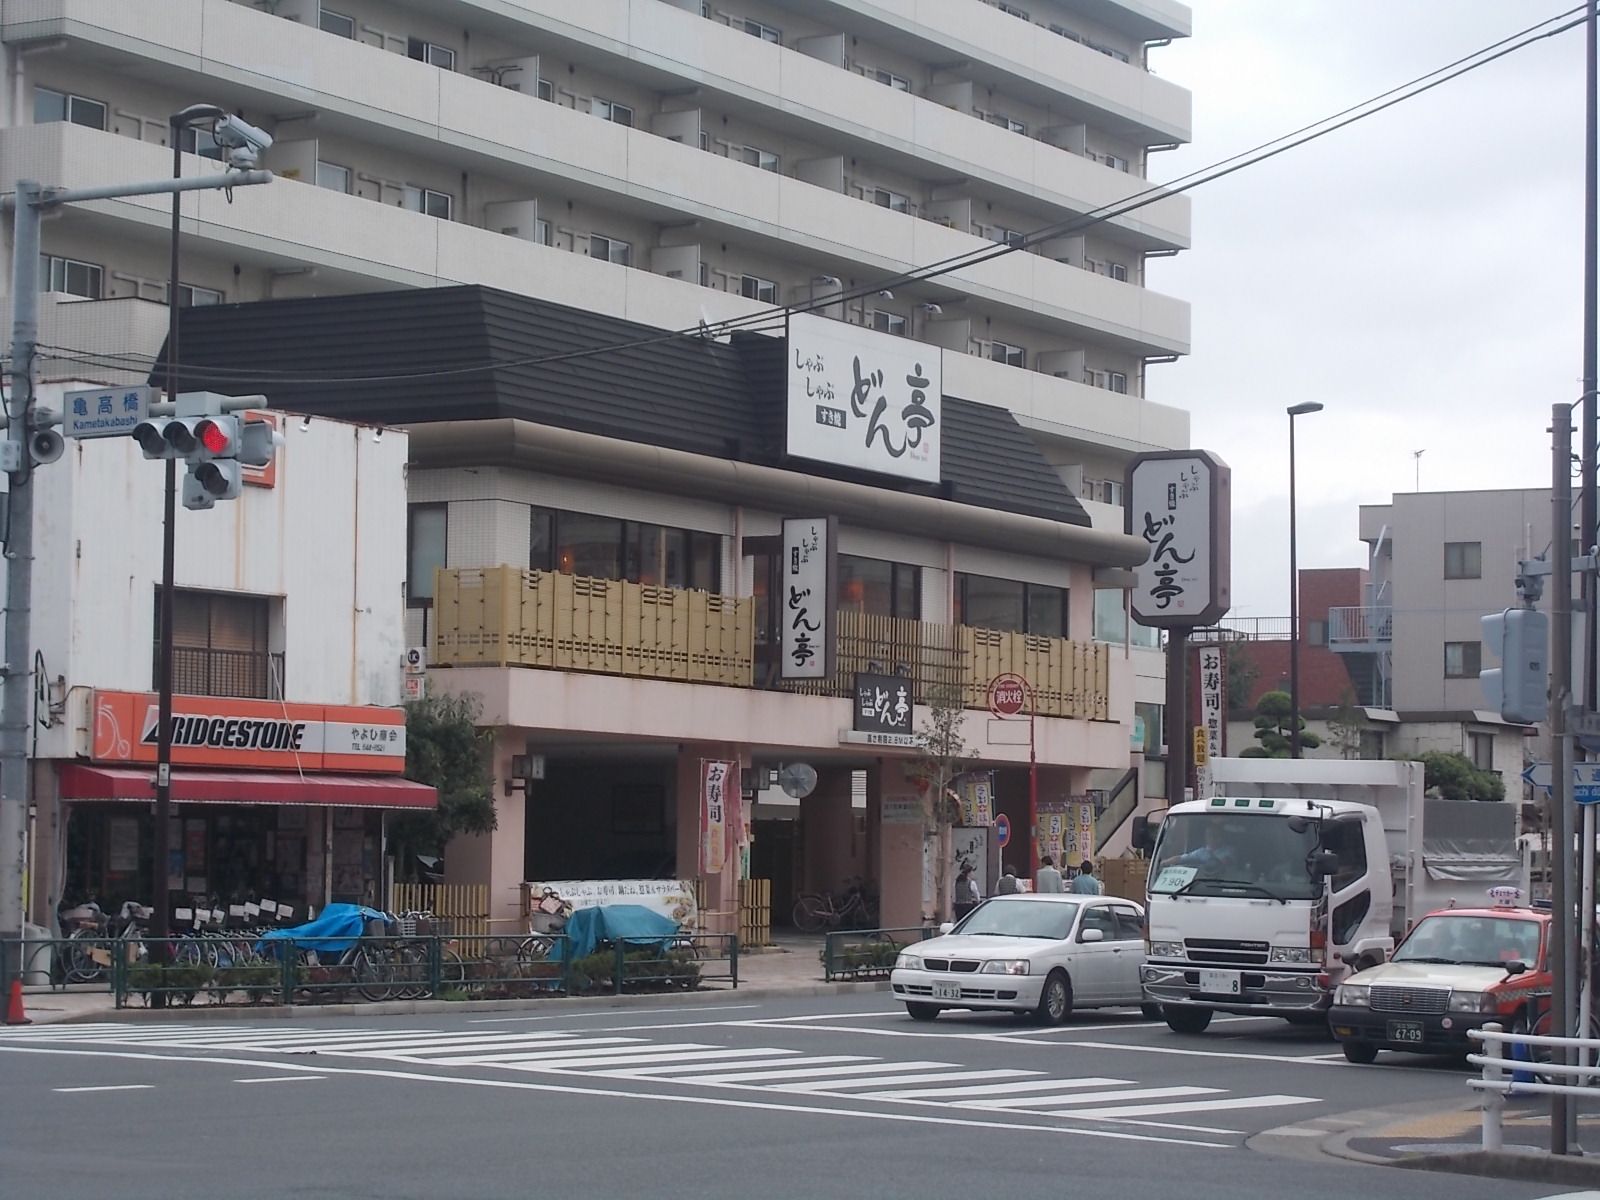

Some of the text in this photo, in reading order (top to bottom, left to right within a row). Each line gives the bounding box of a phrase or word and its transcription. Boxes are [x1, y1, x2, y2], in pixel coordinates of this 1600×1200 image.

[796, 348, 824, 373] しゃぶ
[806, 376, 835, 400] しゃぶ
[73, 392, 138, 416] 亀高橋
[851, 355, 935, 458] どん亭
[74, 416, 138, 430] Kametakabashi
[1142, 511, 1196, 609] どん亭
[788, 585, 821, 667] どん亭
[874, 686, 910, 726] どん亭
[996, 689, 1023, 704] 消火栓
[708, 766, 724, 823] お寿司
[1395, 1029, 1422, 1041] 67-09
